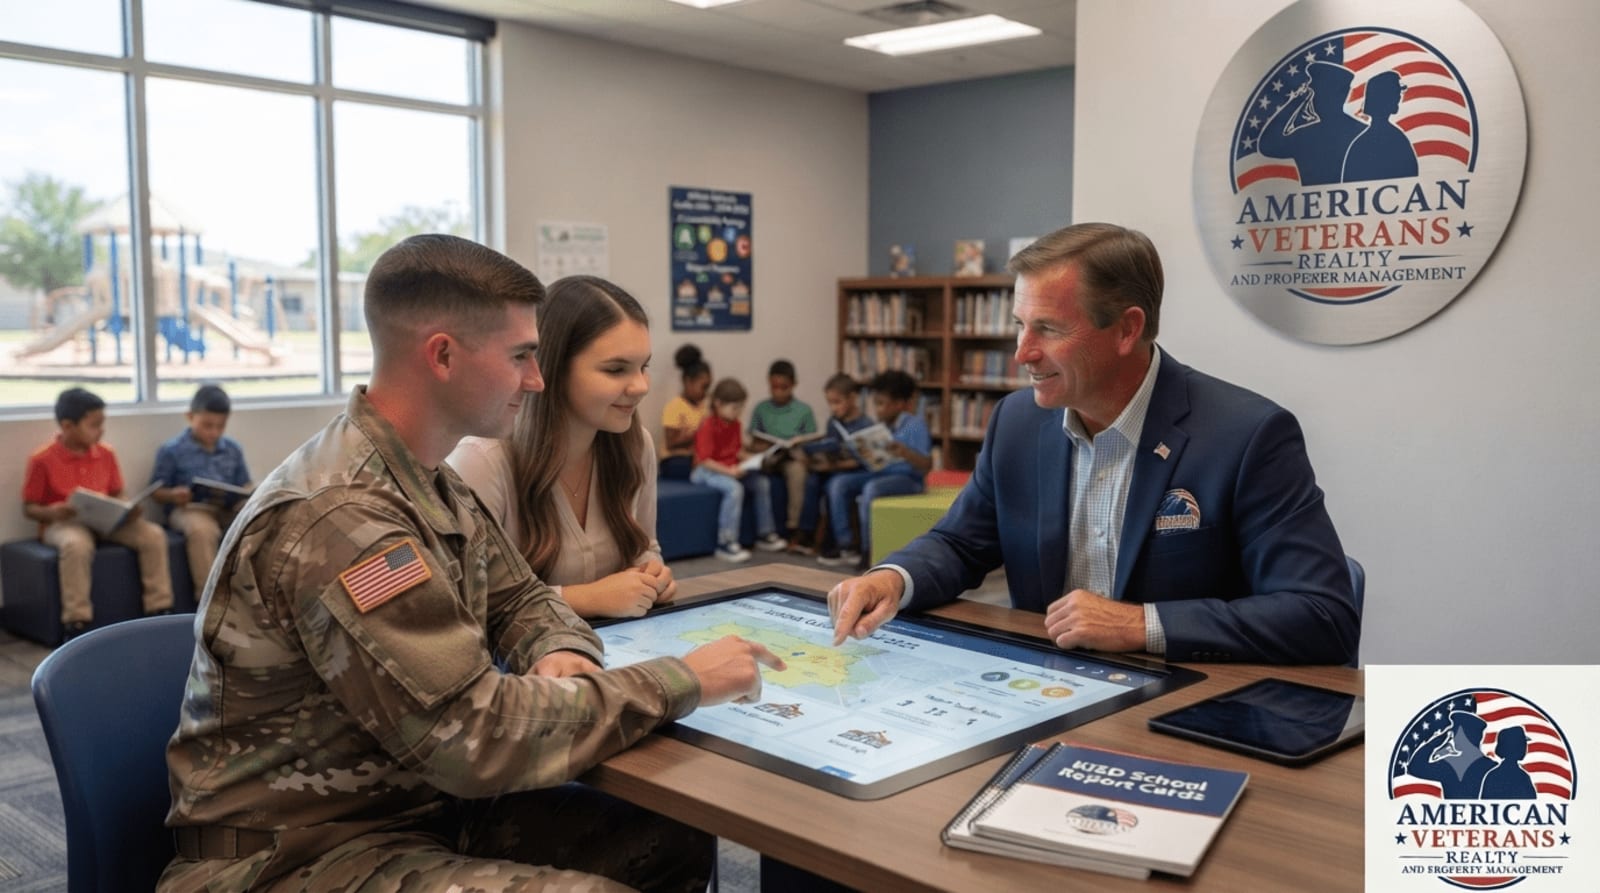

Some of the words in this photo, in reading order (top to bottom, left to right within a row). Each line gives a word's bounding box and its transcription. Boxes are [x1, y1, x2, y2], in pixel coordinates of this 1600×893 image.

[1236, 179, 1470, 224] AMERICAN
[1248, 217, 1450, 253] VETERANS
[1298, 250, 1393, 269] REALTY
[1230, 273, 1260, 286] AND
[1343, 267, 1467, 283] MANAGEMENT
